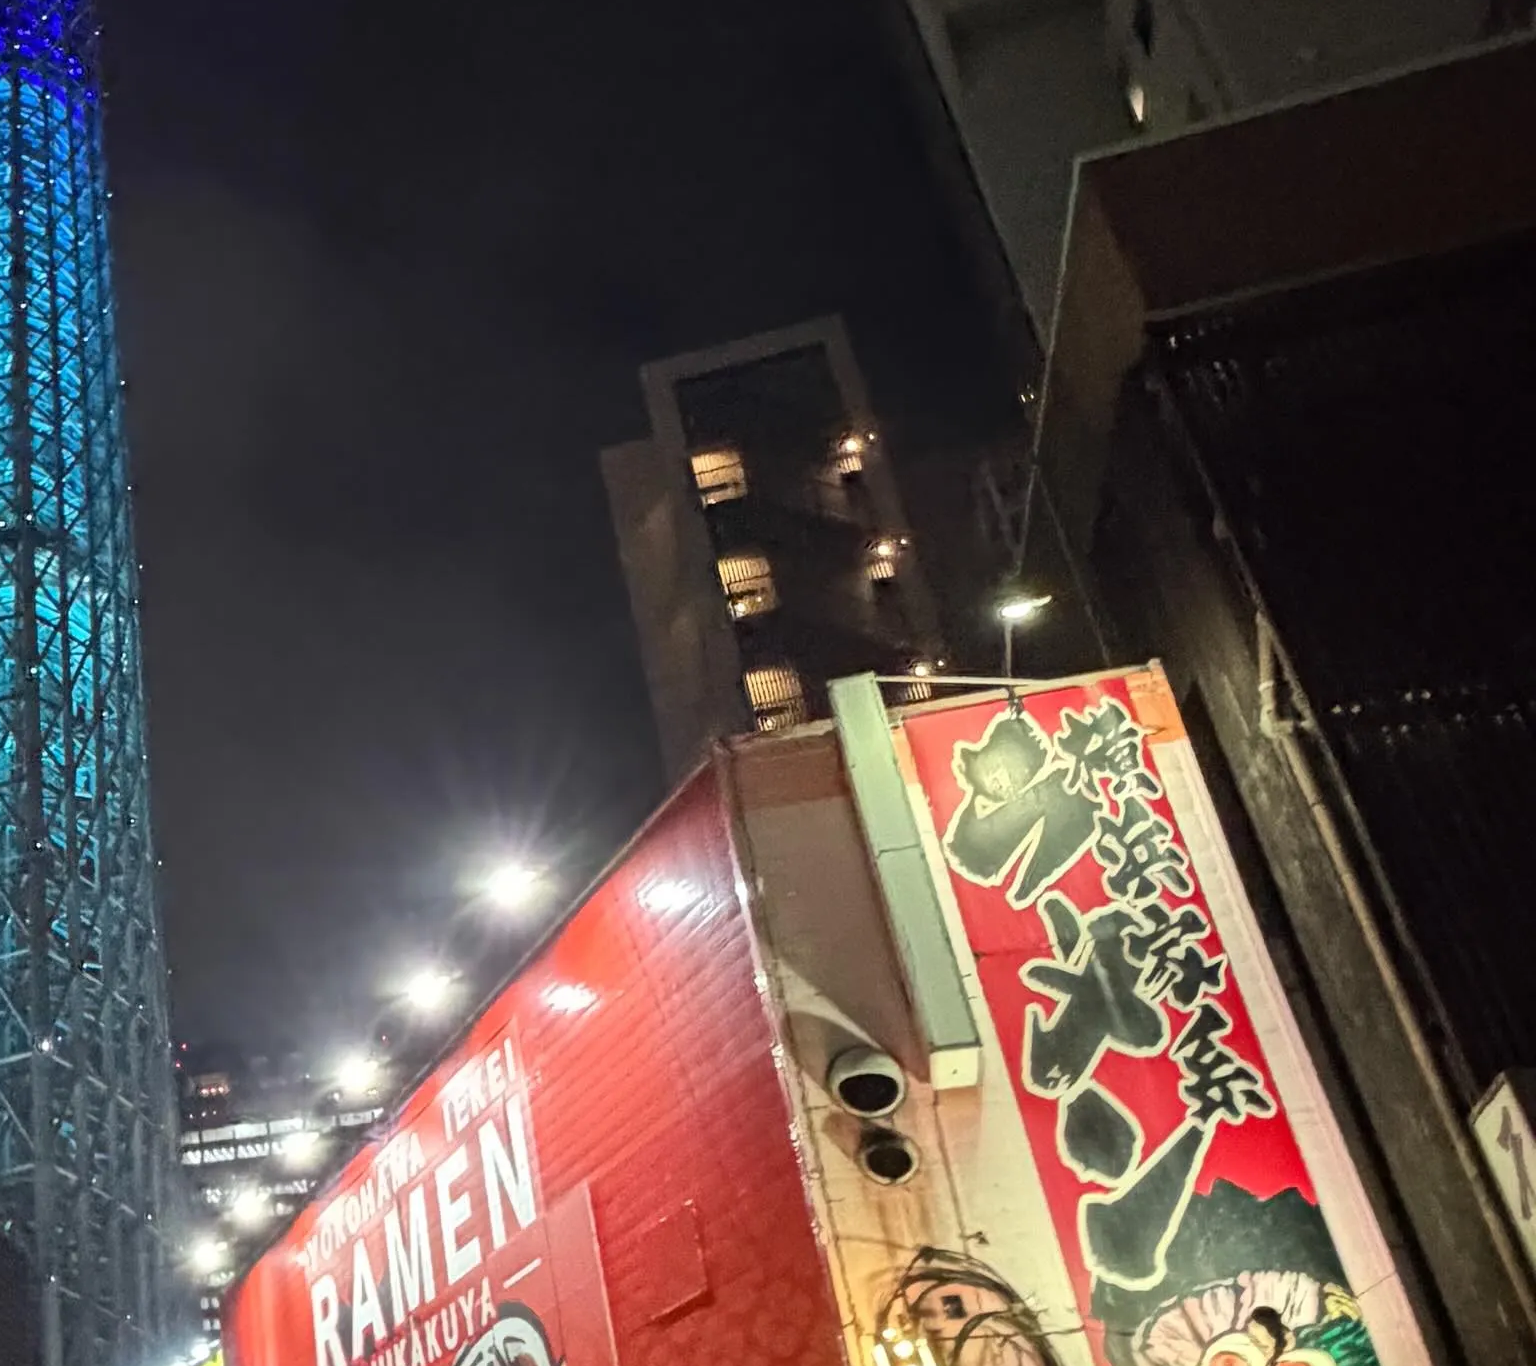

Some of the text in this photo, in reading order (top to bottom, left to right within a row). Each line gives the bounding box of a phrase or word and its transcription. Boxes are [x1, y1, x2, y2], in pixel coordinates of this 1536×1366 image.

[1052, 696, 1277, 1126] 横浜家系
[441, 1037, 517, 1142] IEKEI
